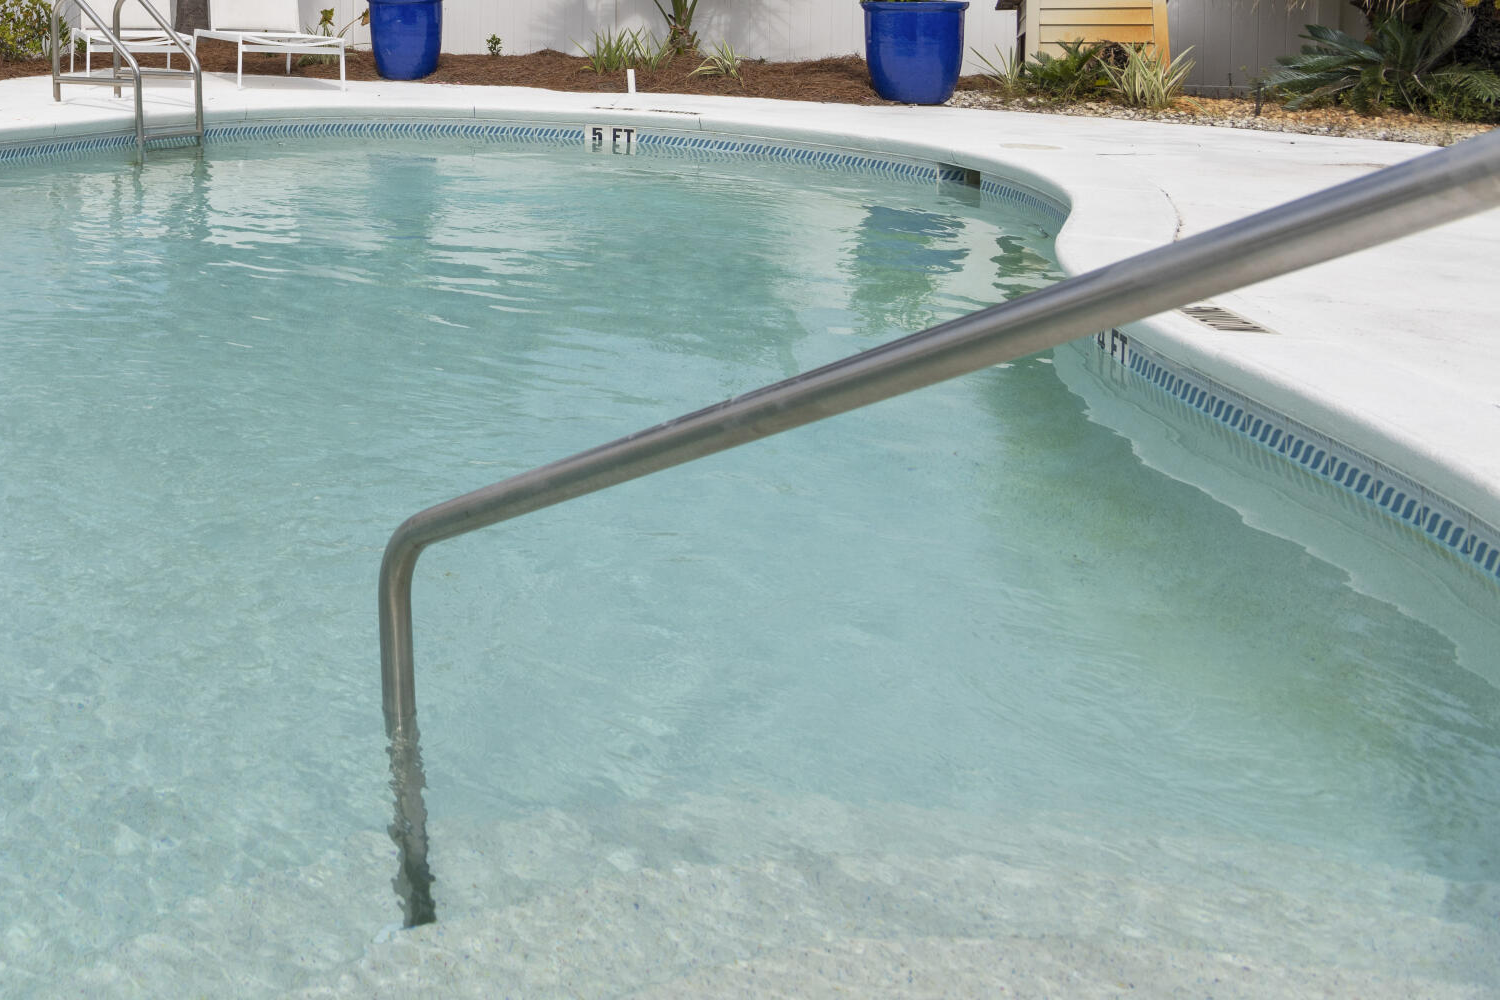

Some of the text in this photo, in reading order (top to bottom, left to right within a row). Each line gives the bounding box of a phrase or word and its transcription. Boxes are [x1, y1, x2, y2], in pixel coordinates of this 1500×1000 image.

[592, 127, 634, 143] 5 FT
[1097, 328, 1128, 365] 4 FT
